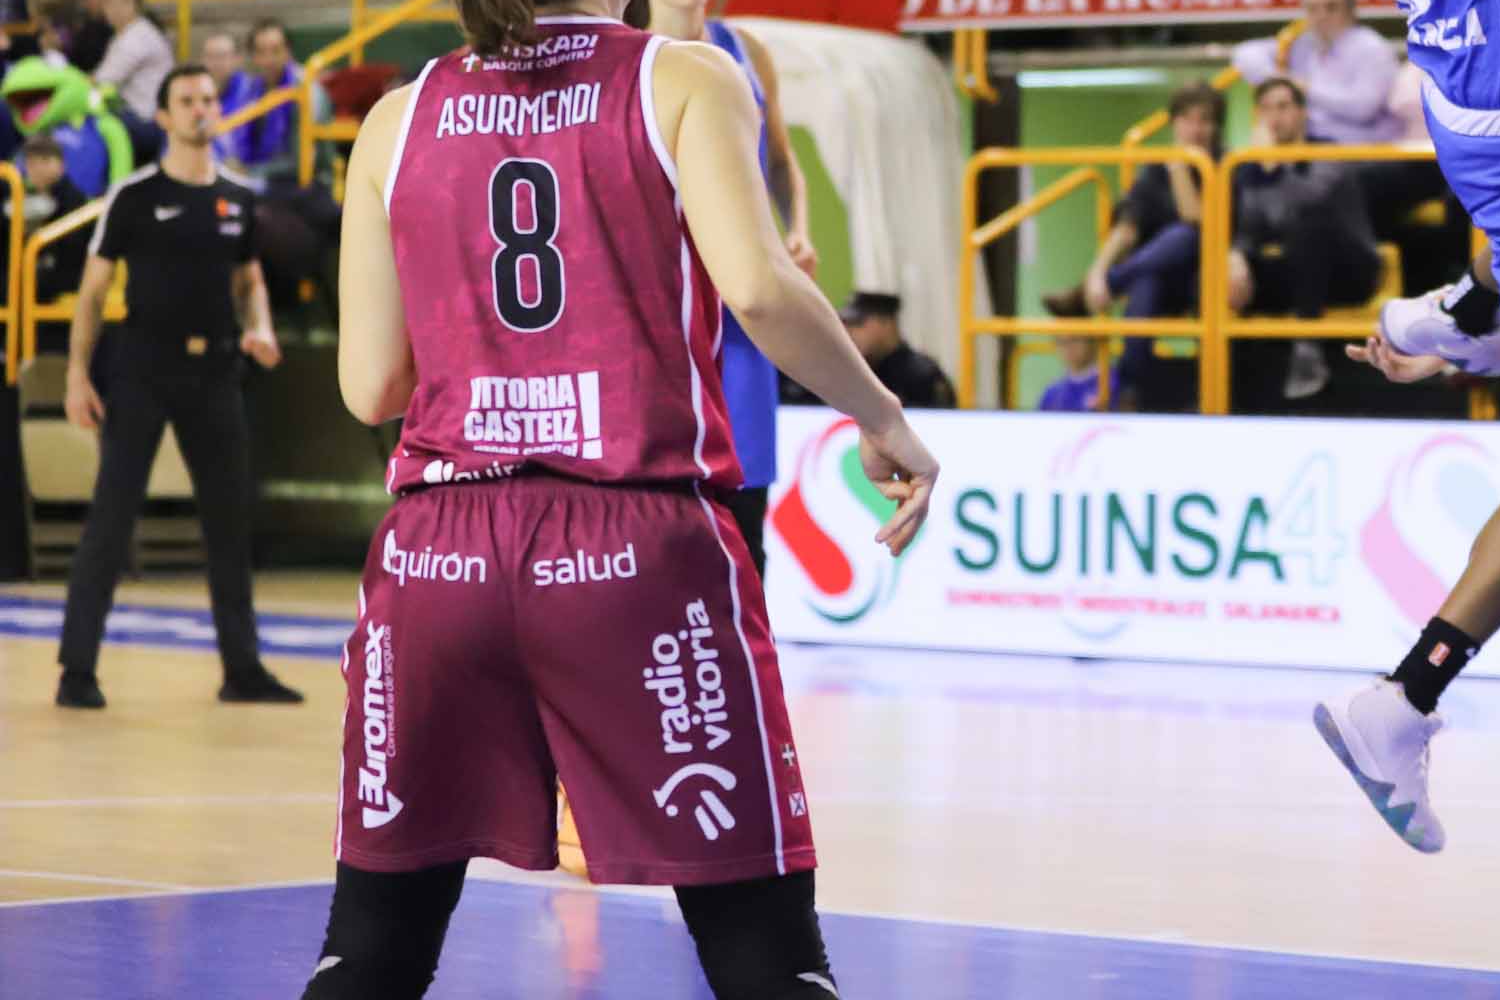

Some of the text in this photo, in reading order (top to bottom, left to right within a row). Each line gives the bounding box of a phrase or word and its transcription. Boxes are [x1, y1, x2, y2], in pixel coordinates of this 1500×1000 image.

[482, 50, 595, 72] BASQUE COUNTRY
[436, 82, 601, 139] ASURMENDI
[488, 157, 566, 333] 8
[463, 408, 579, 444] GASTEIZ
[532, 542, 638, 587] salud
[358, 619, 388, 806] Euromex
[643, 632, 693, 755] radio
[679, 597, 732, 751] vitoria
